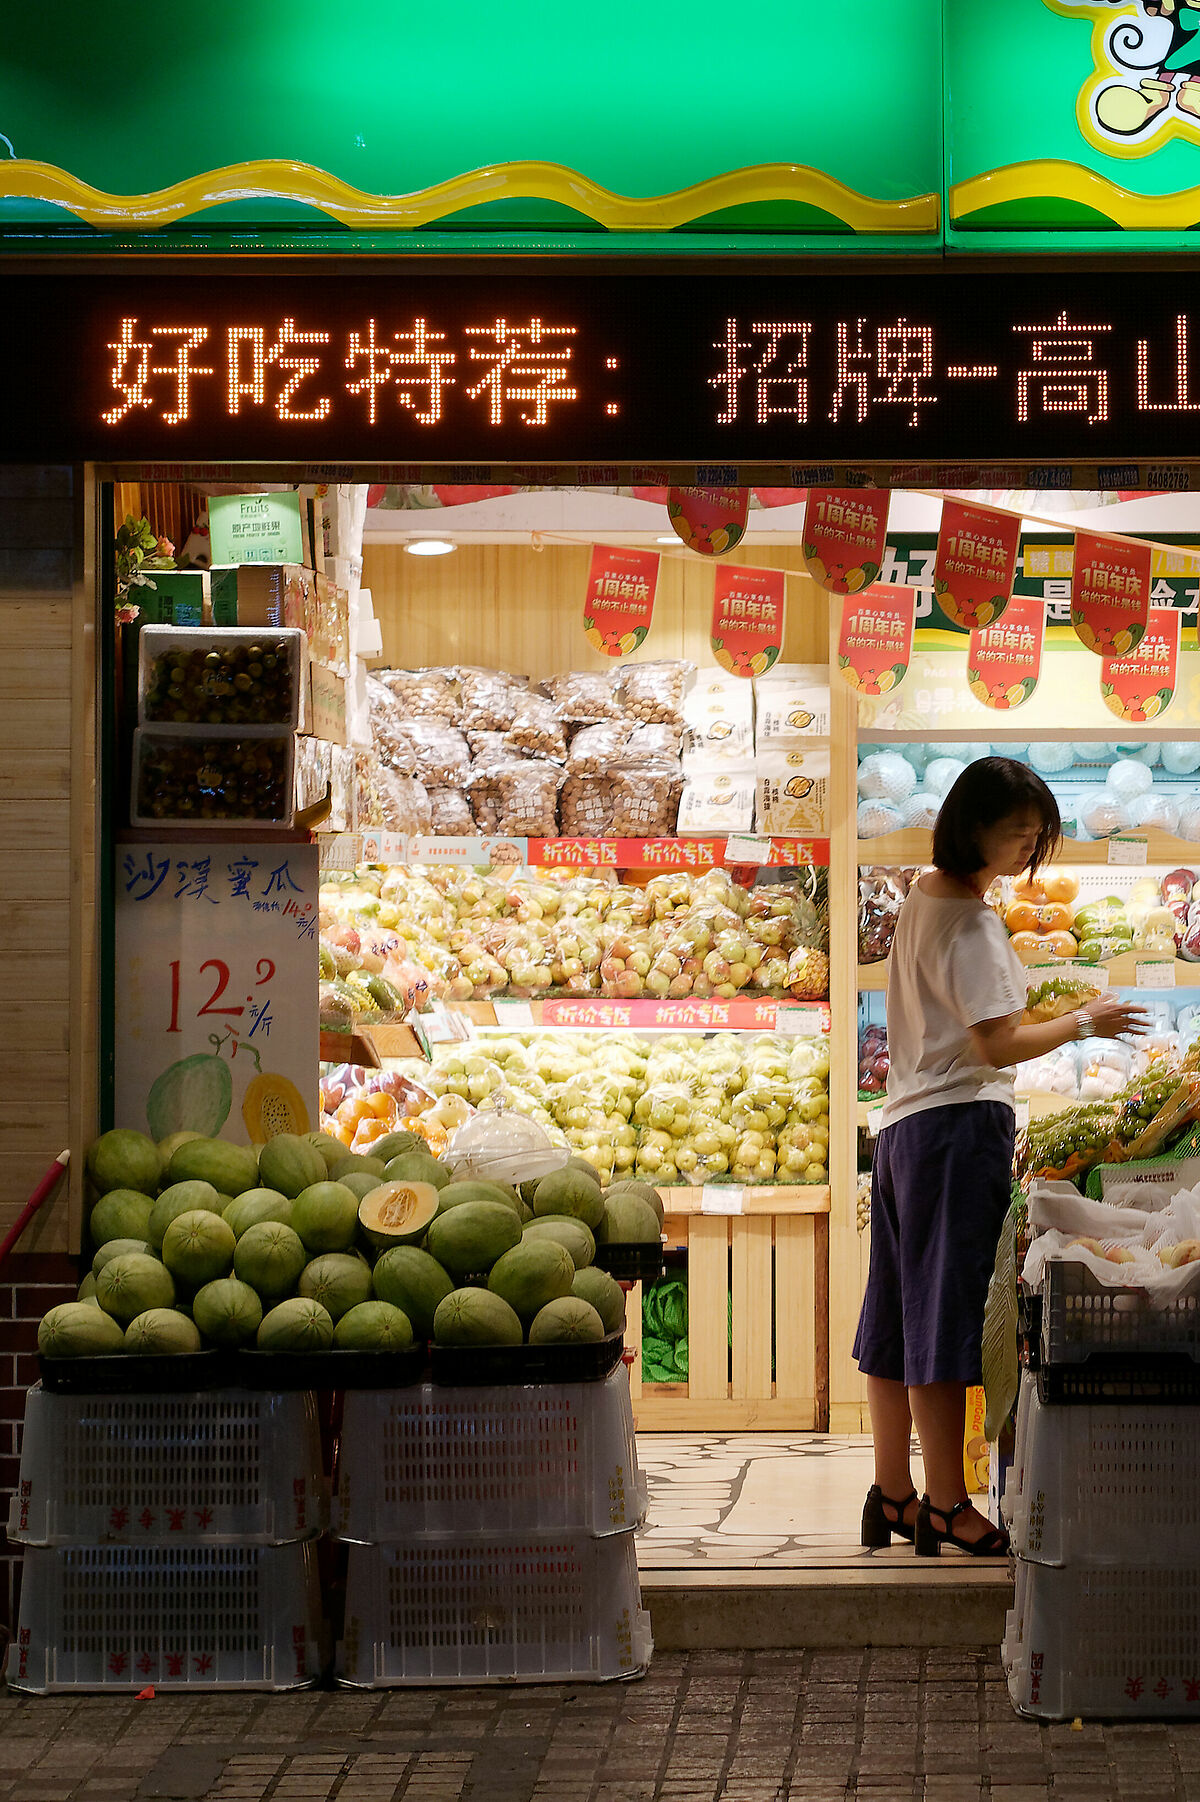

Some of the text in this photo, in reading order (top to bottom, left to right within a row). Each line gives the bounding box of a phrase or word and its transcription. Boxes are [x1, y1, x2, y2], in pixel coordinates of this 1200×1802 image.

[240, 502, 270, 514] Fruits
[815, 501, 879, 535] 1周年庆
[946, 536, 1009, 568] 1周年庆
[594, 577, 651, 601] 1周年庆
[1080, 567, 1143, 596] 1周年庆
[719, 598, 777, 621] 1周年庆
[848, 615, 906, 639] 1周年庆
[978, 628, 1036, 651] 1周年庆
[542, 841, 618, 864] 折价专区
[642, 841, 715, 865] 折价专区
[556, 1005, 632, 1026] 折价专区
[655, 1003, 731, 1025] 折价专区
[109, 1507, 215, 1531] 水果专卖
[109, 1652, 214, 1677] 水果专卖
